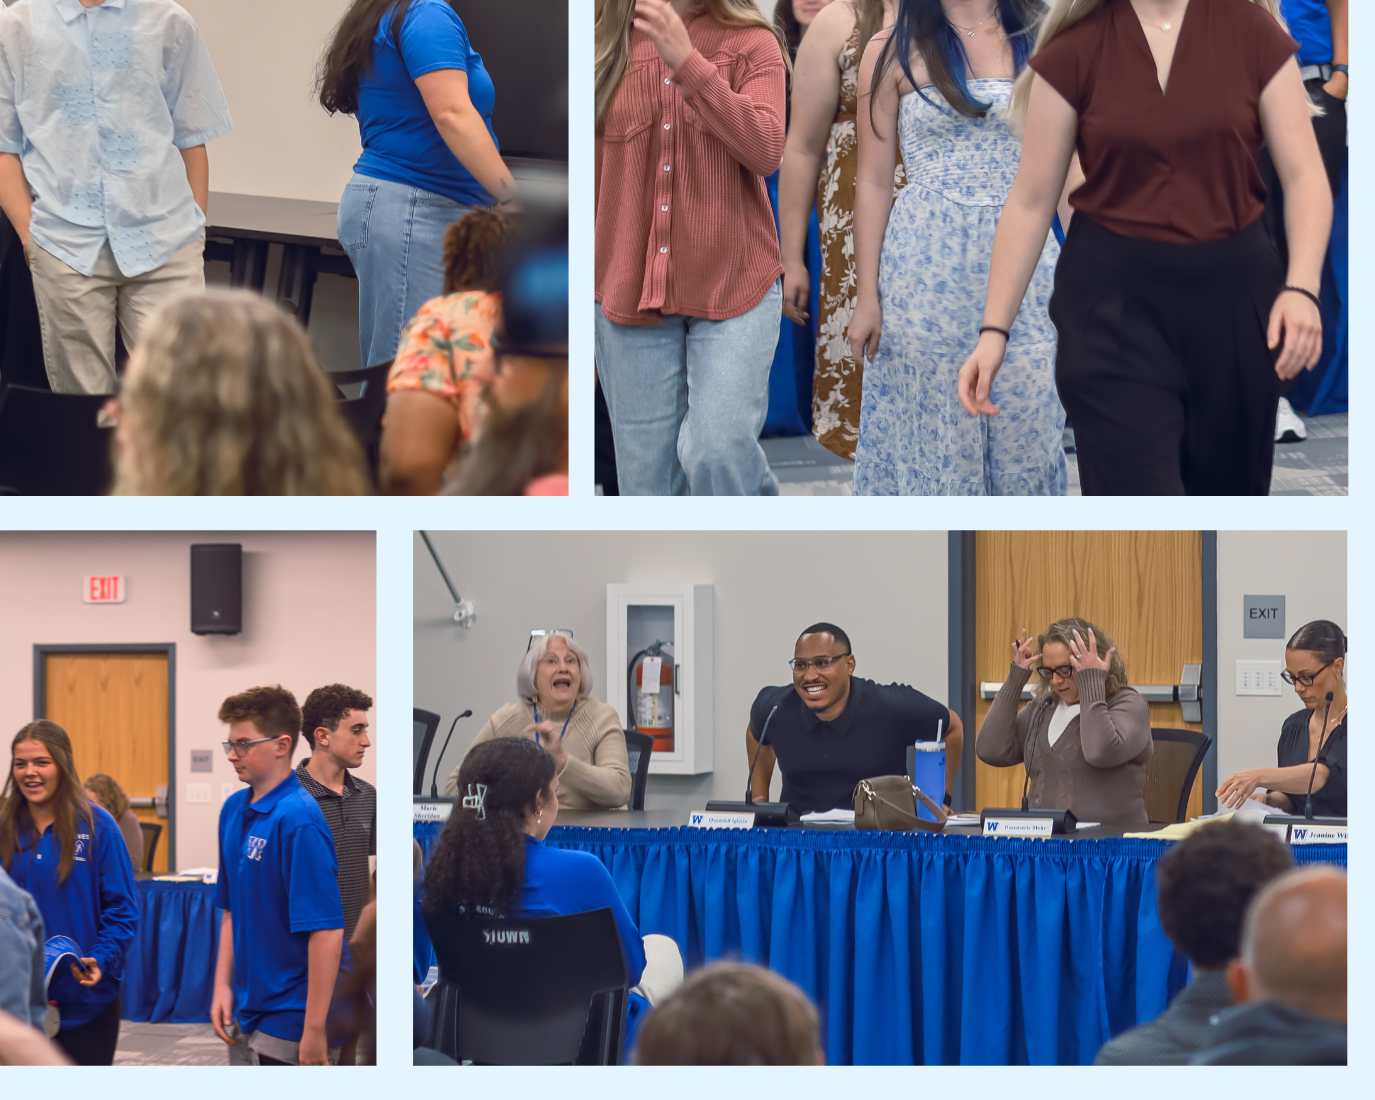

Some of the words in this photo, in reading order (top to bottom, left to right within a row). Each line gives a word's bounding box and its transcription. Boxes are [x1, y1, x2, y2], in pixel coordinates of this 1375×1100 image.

[89, 576, 120, 601] EXIT
[1249, 607, 1279, 620] EXIT
[692, 815, 704, 825] W
[987, 821, 1000, 832] W
[1293, 829, 1309, 841] W
